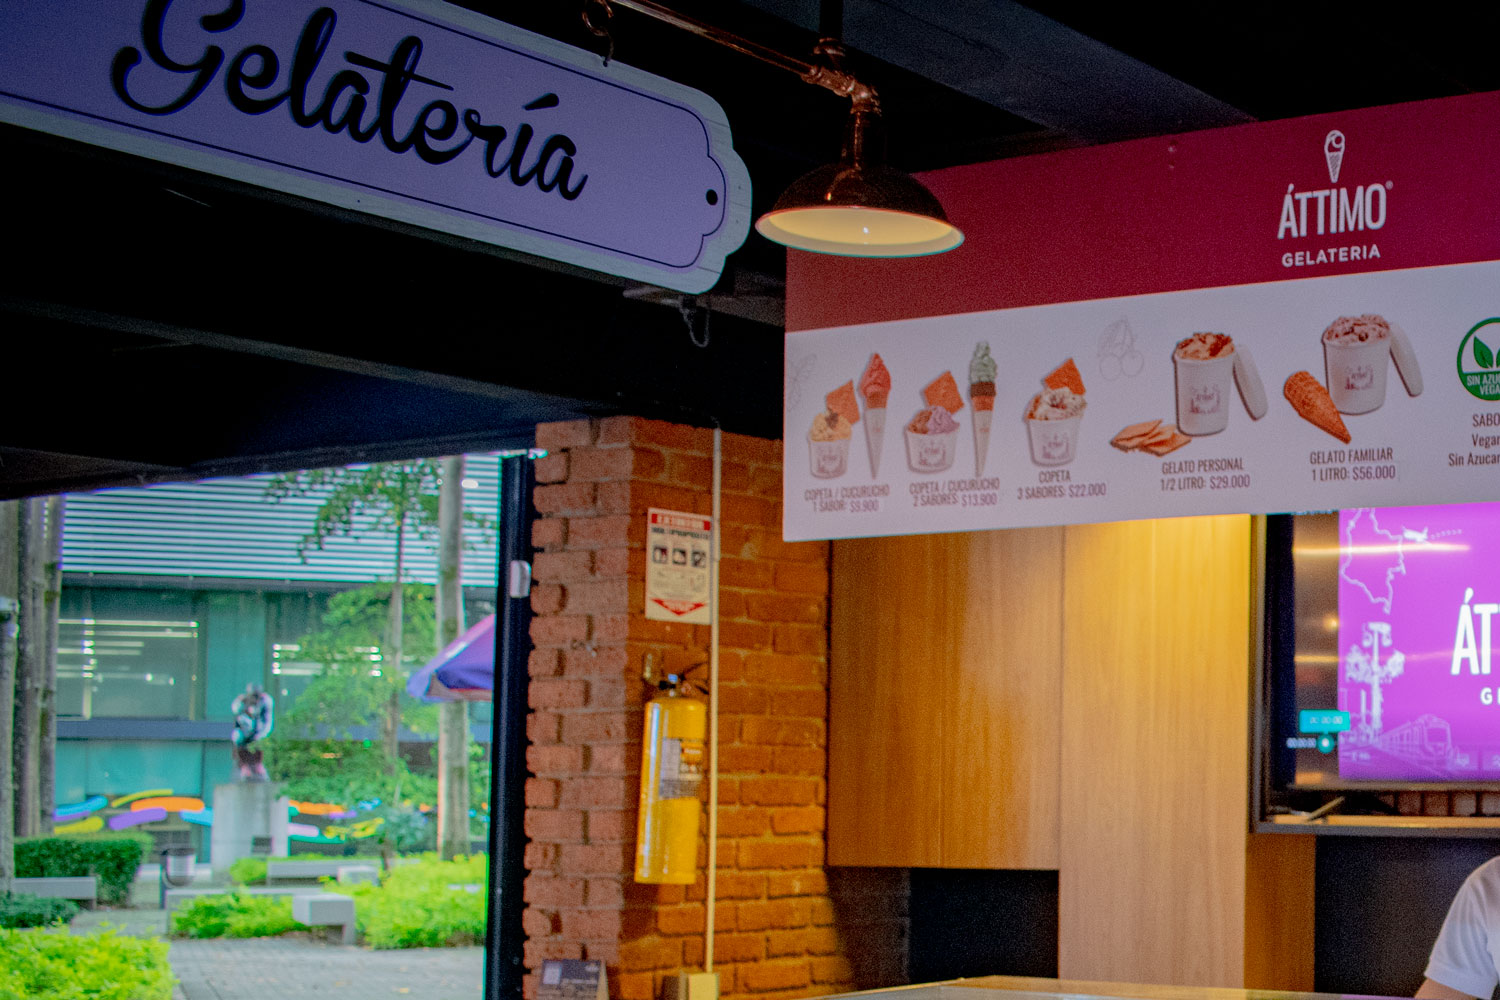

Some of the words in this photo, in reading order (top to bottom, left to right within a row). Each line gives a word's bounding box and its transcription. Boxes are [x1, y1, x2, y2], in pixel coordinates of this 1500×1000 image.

[111, 0, 589, 202] Gelatería
[1282, 244, 1381, 268] GELATERIA
[1466, 375, 1480, 387] SIN
[1309, 450, 1346, 465] GELATO
[1348, 447, 1394, 463] FAMILIAR
[1448, 453, 1465, 467] Sin
[1162, 460, 1195, 475] GELATO
[1197, 457, 1244, 473] PERSONAL
[1319, 467, 1350, 482] LITRO:
[1352, 465, 1396, 481] $56.000
[1038, 470, 1071, 483] COPETA
[1160, 478, 1175, 491] 1/2
[1178, 477, 1206, 491] LITRO:
[1209, 474, 1251, 490] $29.000
[804, 487, 833, 501] COPETA
[840, 484, 890, 499] CUCURUCHO
[909, 482, 940, 496] COPETA
[947, 477, 1001, 493] CUCURUCHO
[1017, 487, 1024, 500] 3
[1025, 485, 1066, 500] SABORES:
[1069, 483, 1106, 498] $22.000
